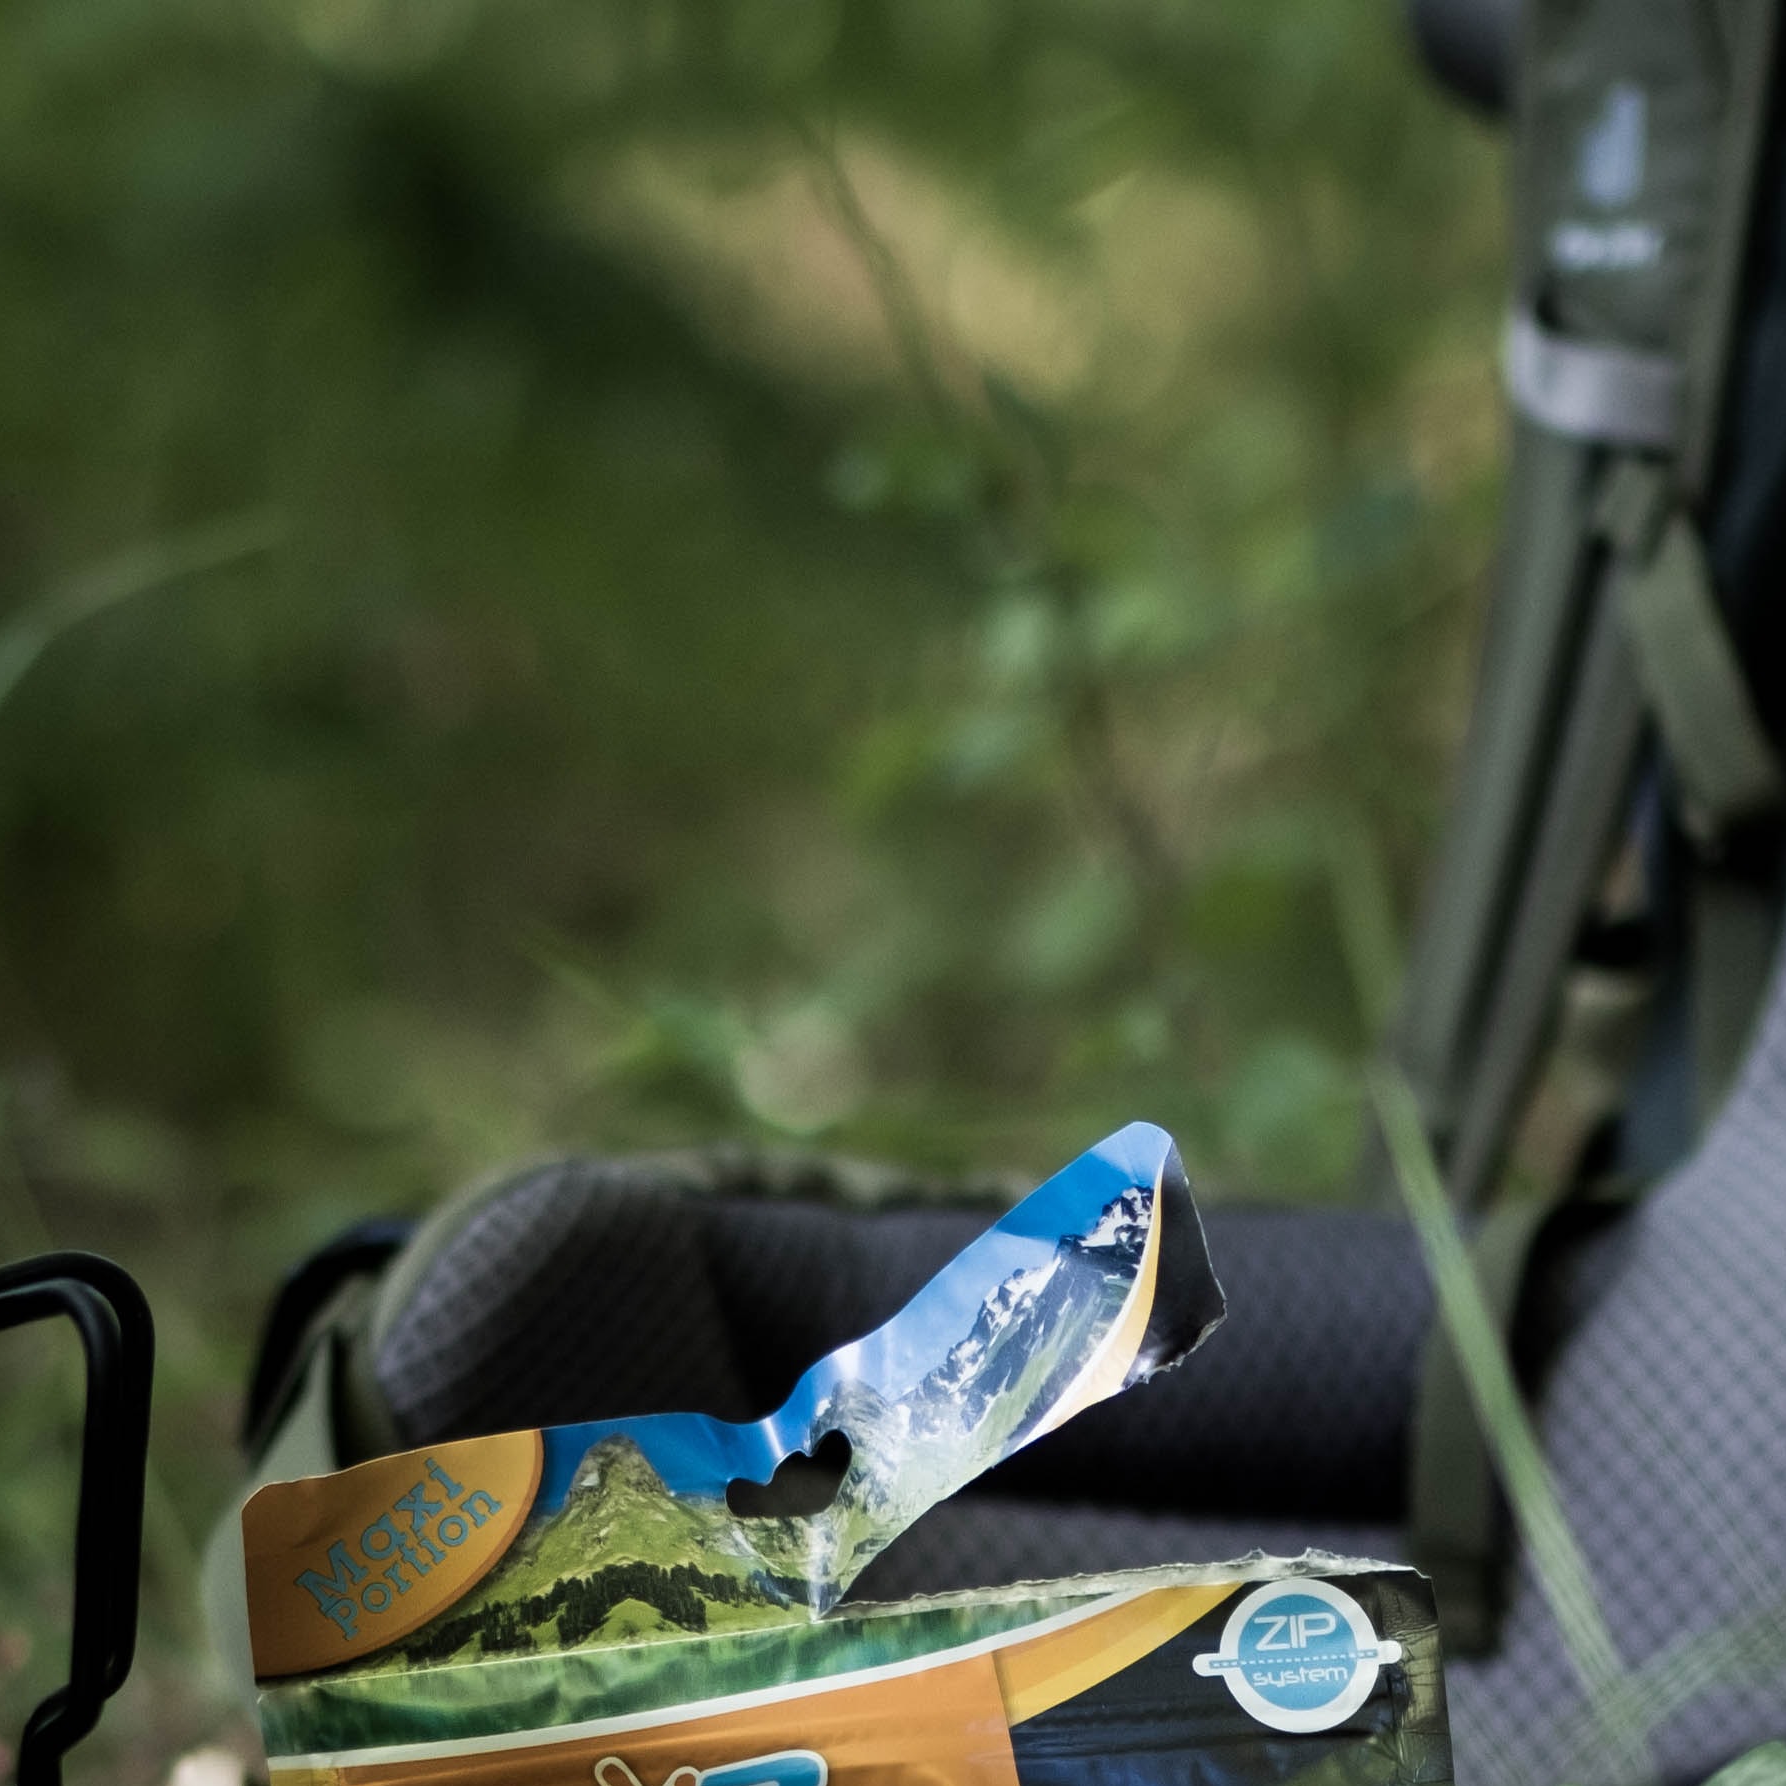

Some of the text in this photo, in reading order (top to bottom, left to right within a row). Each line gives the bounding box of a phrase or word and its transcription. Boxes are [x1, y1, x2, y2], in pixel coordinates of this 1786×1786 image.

[294, 1457, 465, 1615] Maxi
[1254, 1612, 1337, 1651] ZIP
[1253, 1666, 1349, 1688] system
